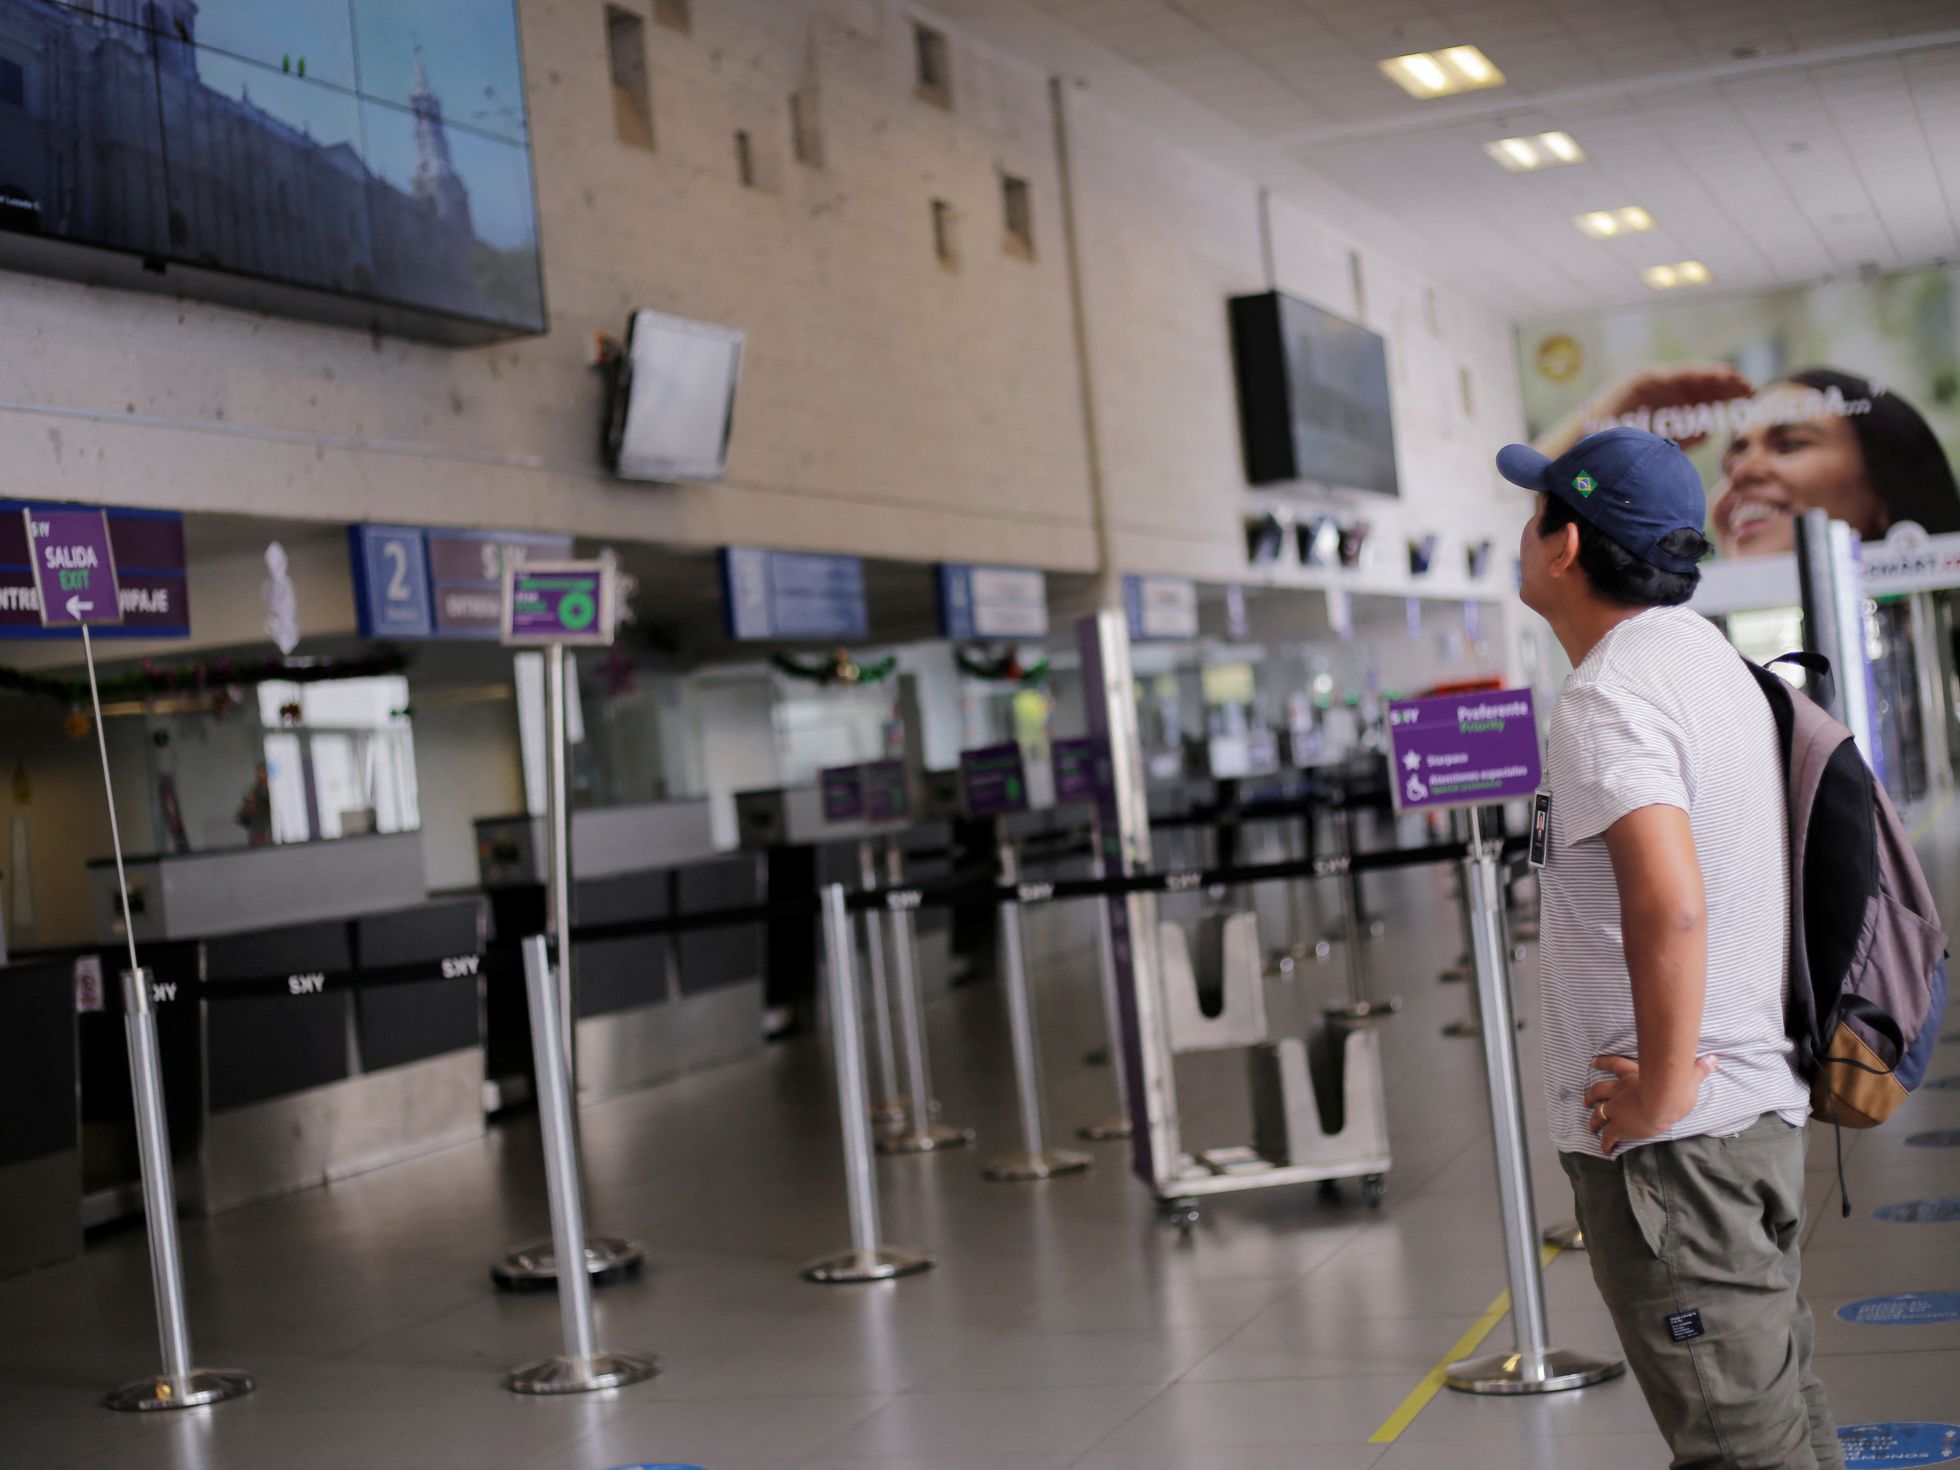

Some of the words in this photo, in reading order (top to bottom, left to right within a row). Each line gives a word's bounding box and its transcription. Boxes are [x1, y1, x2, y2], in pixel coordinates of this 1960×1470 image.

[45, 545, 98, 569] SALIDA
[59, 568, 90, 591] EXIT
[384, 539, 411, 600] 2
[1457, 702, 1529, 721] Preferente
